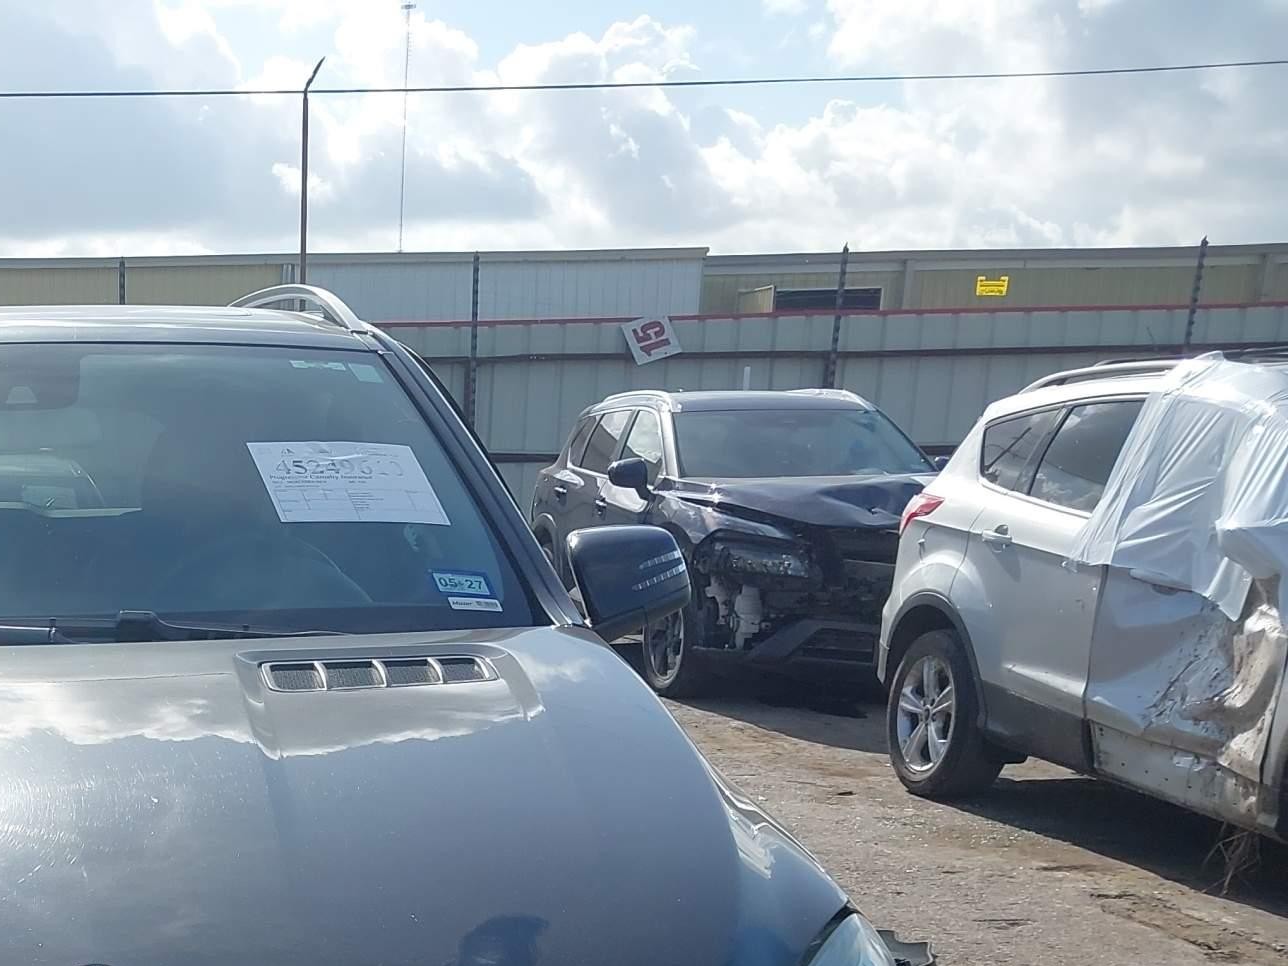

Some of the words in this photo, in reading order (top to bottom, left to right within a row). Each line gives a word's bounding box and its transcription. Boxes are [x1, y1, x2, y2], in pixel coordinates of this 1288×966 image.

[632, 320, 671, 357] 15
[438, 577, 458, 588] 05
[465, 579, 482, 590] 27
